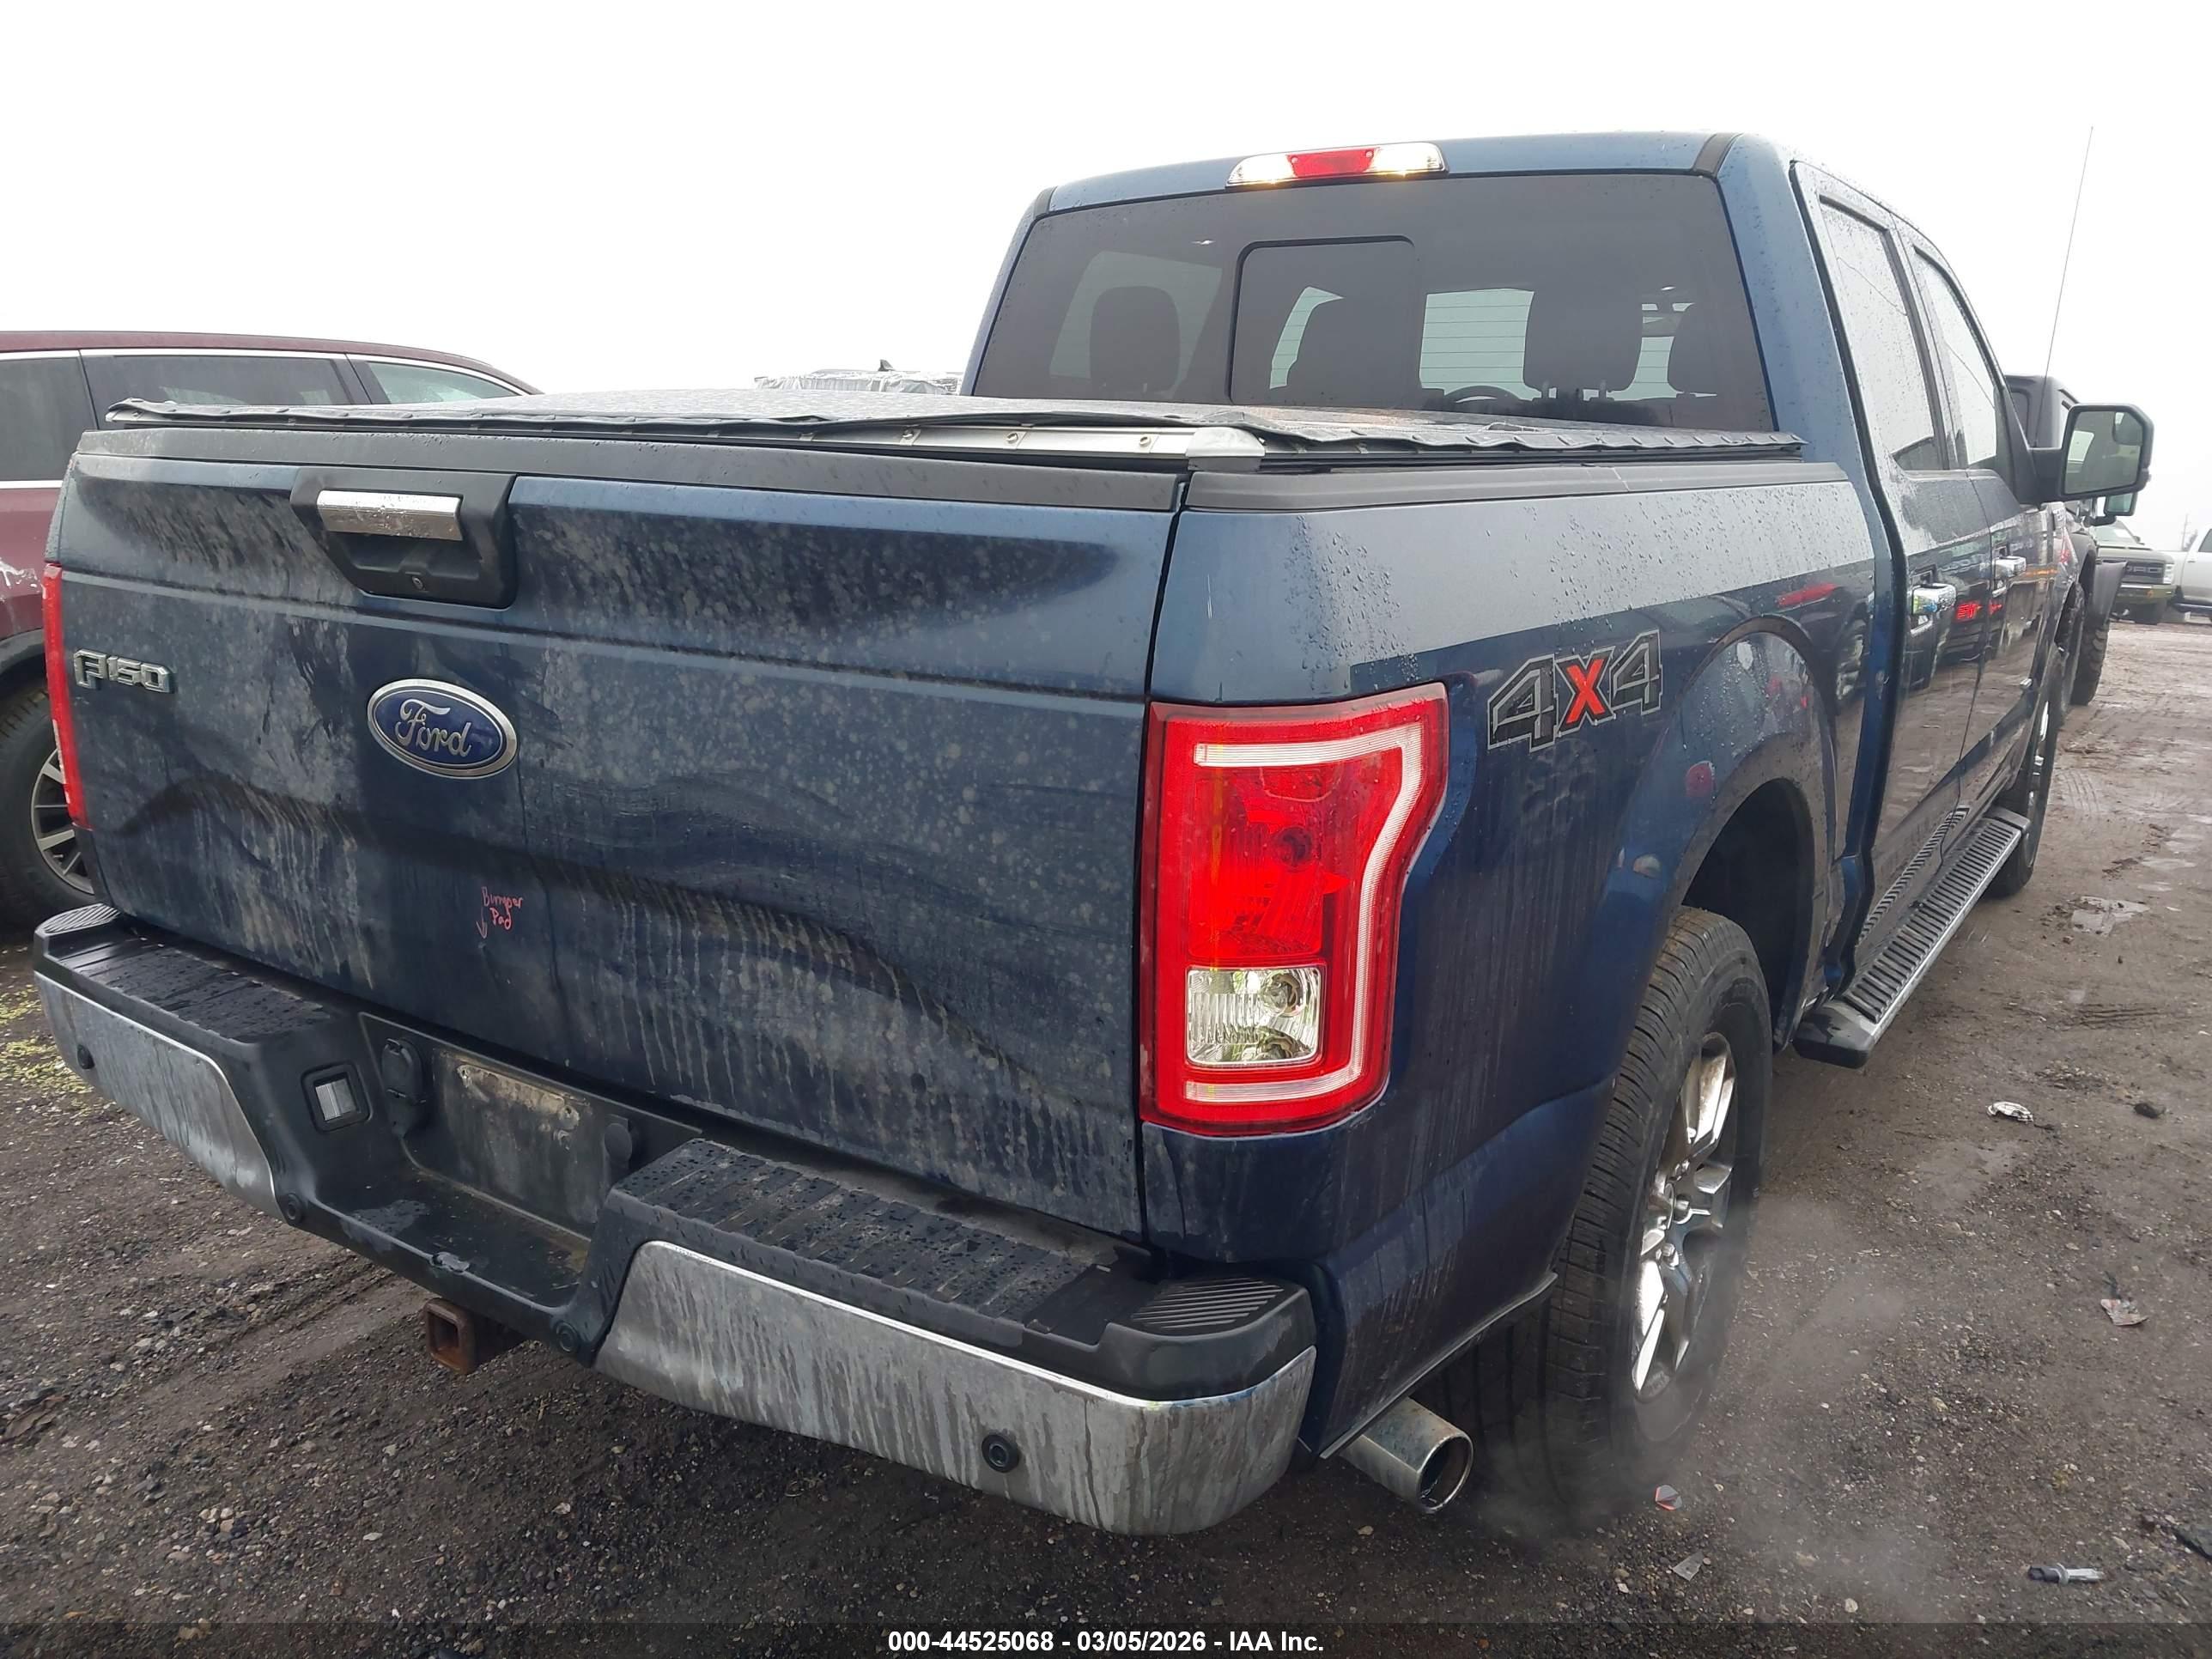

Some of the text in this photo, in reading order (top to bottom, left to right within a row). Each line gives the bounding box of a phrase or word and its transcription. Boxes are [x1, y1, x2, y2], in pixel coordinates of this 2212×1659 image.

[395, 698, 472, 757] Ford
[481, 886, 524, 915] Bumper
[489, 907, 512, 930] Pad
